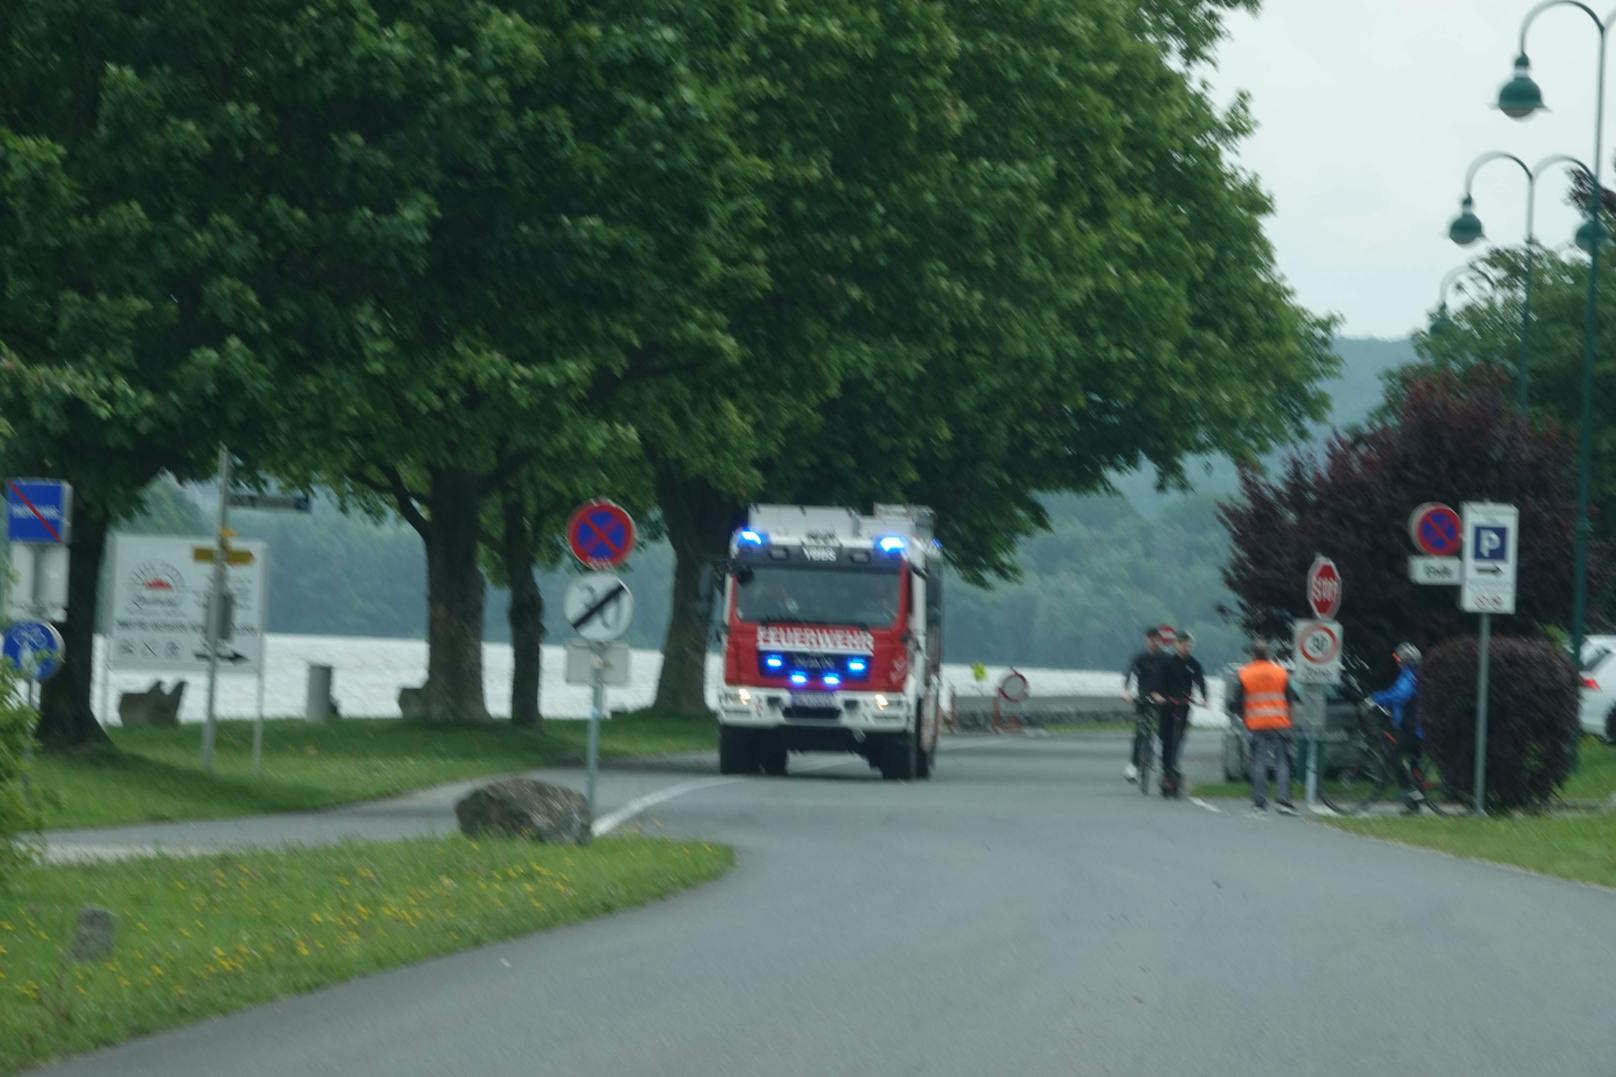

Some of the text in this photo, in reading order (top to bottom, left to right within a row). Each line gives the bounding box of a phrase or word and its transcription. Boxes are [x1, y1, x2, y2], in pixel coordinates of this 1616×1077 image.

[1479, 529, 1501, 557] P
[1312, 576, 1338, 601] STOP
[757, 626, 875, 651] FEUERWEHR
